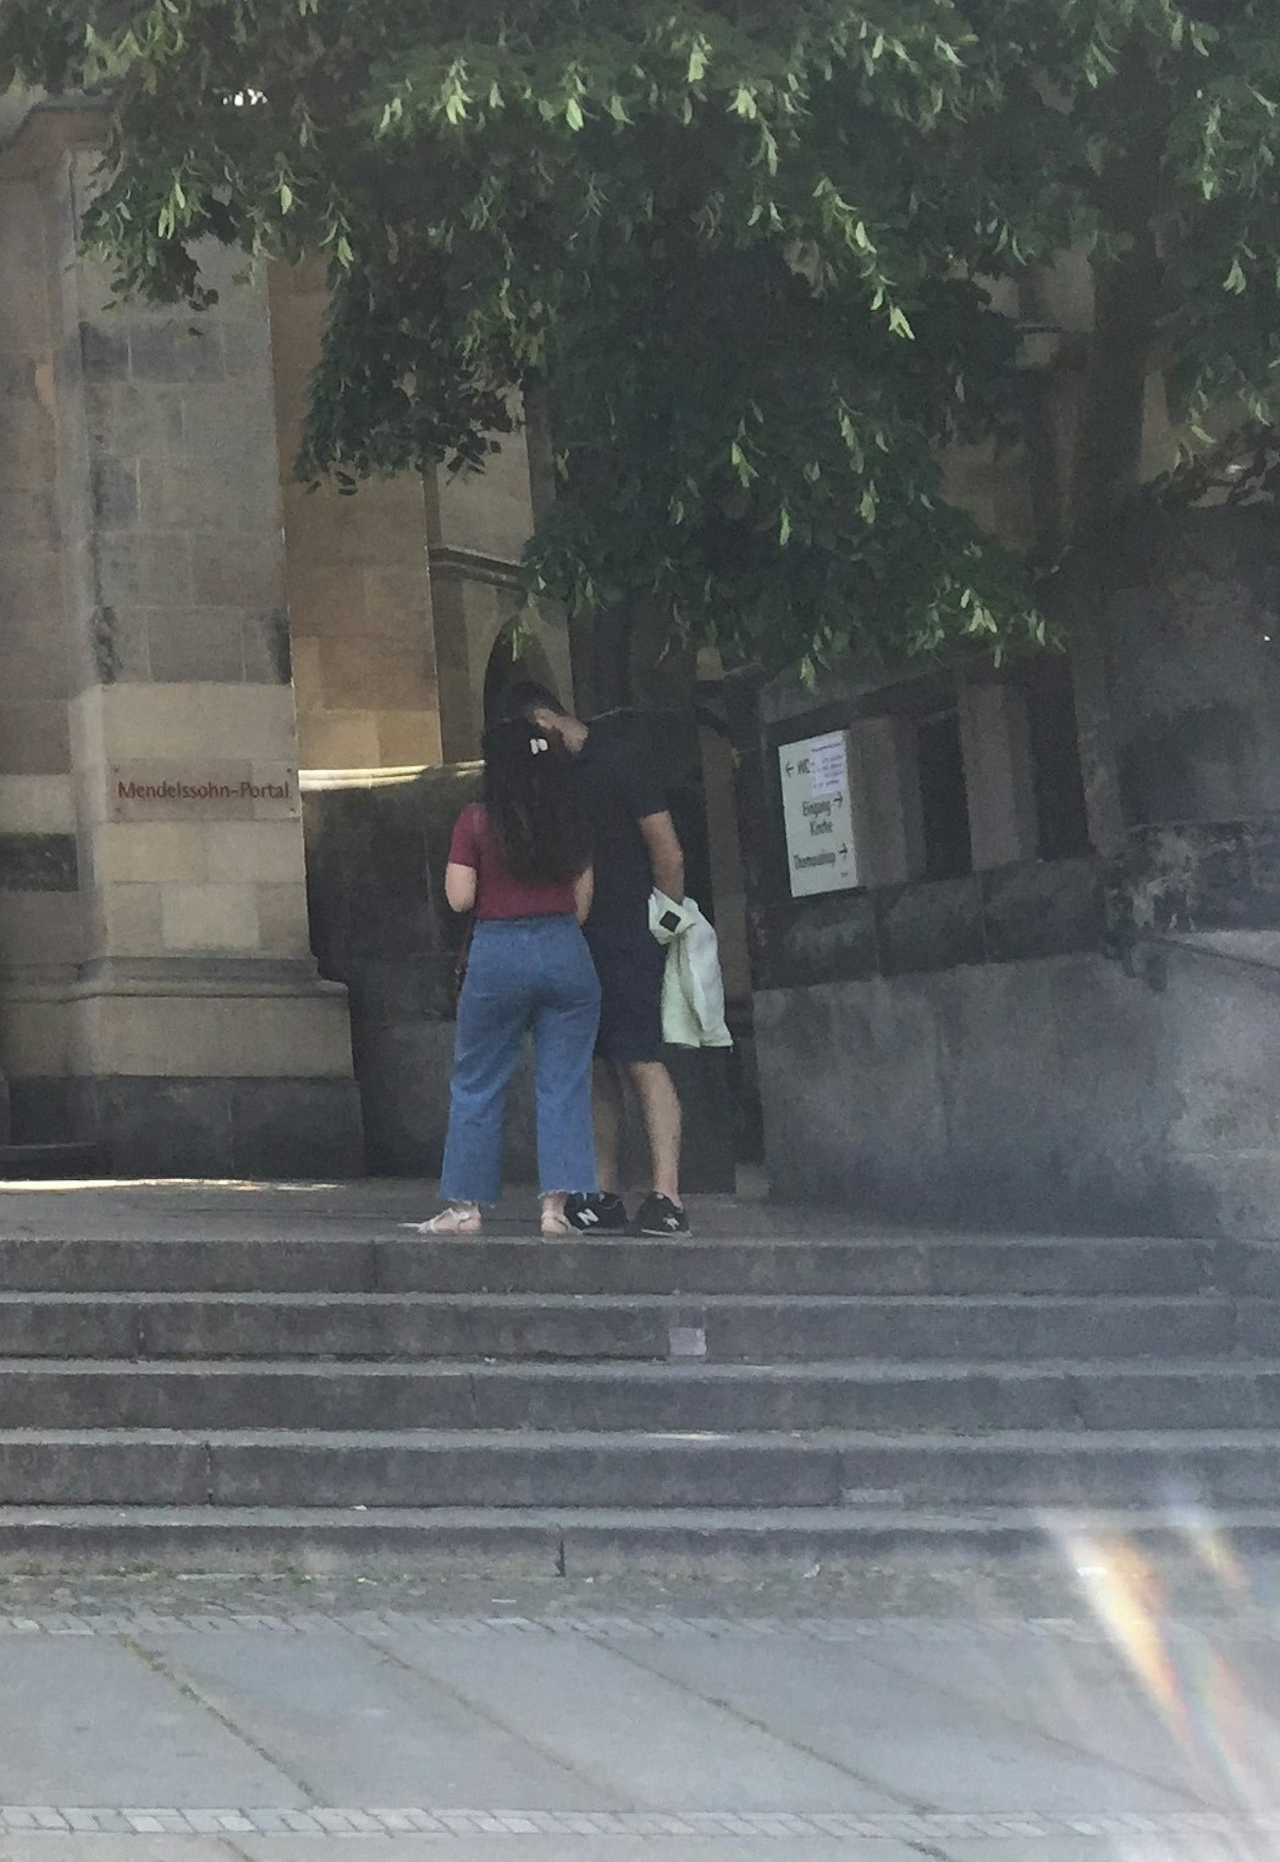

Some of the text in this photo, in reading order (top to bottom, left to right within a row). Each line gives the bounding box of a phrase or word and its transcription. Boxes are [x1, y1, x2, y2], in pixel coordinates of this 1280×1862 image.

[118, 780, 289, 800] Mendelssohn-Portal
[802, 801, 831, 818] Eingang
[577, 1208, 599, 1225] N
